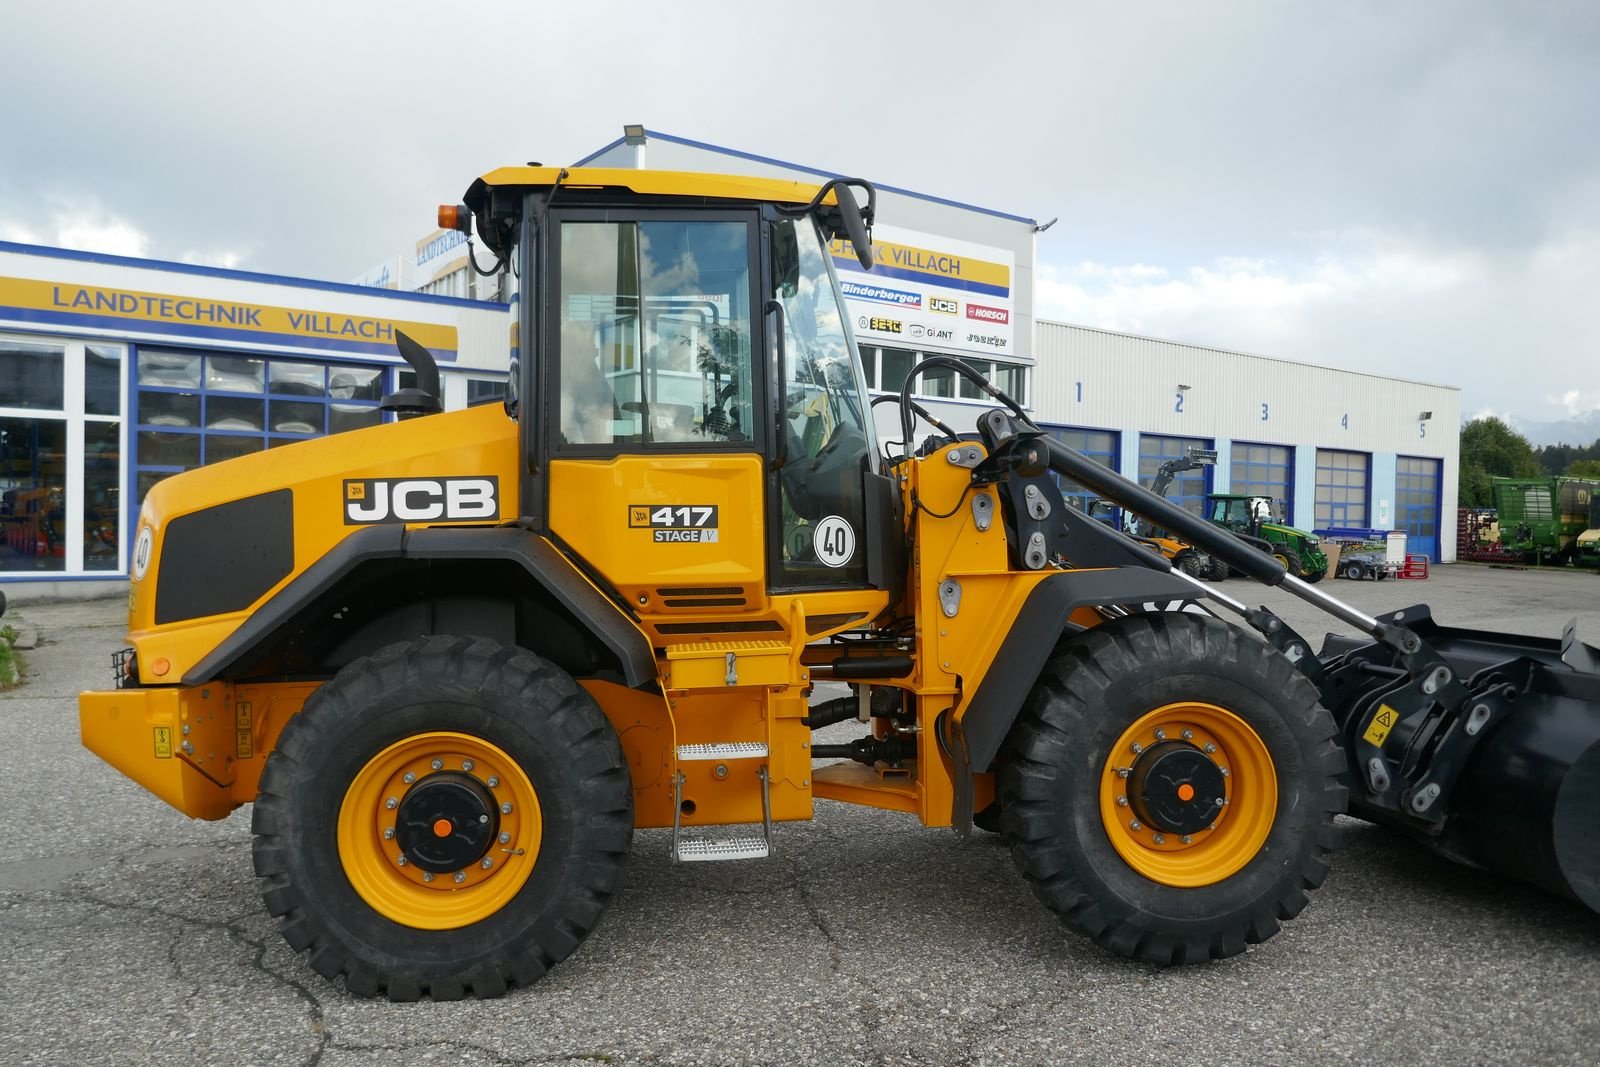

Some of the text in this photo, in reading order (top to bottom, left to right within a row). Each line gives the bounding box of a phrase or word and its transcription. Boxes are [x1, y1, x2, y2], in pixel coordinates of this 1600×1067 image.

[891, 247, 961, 275] VILLACH
[841, 284, 919, 303] Binderberger
[53, 286, 393, 340] LANDTECHNIK VILLACH
[930, 299, 957, 313] JCB
[975, 308, 1006, 321] HORSCH
[1076, 382, 1082, 402] 1
[1175, 394, 1184, 413] 2
[1261, 403, 1269, 421] 3
[1341, 413, 1348, 430] 4
[1420, 423, 1426, 438] 5
[348, 480, 496, 521] JCB
[652, 507, 713, 526] 417
[655, 531, 699, 542] STAGE
[824, 527, 846, 556] 40
[136, 537, 148, 568] 40
